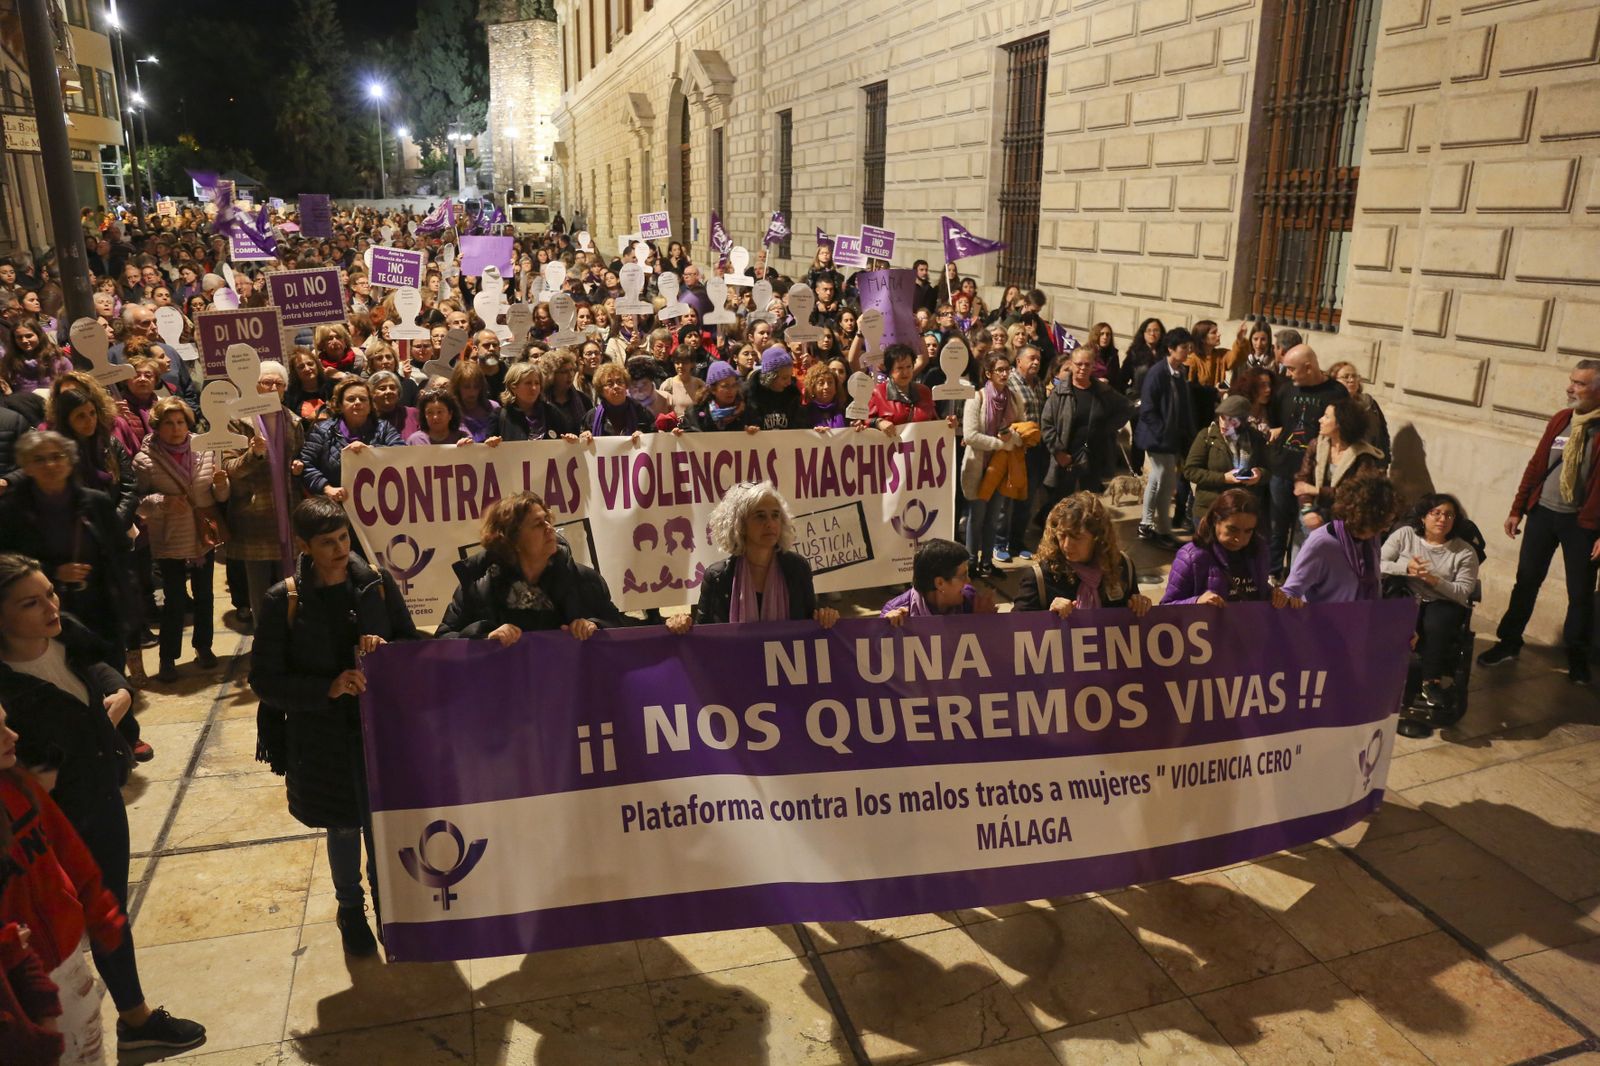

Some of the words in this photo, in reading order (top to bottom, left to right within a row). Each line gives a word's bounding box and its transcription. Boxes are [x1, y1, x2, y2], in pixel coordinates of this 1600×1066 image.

[377, 272, 386, 282] TE
[387, 262, 404, 274] ¡NO
[387, 273, 414, 286] CALLES!
[284, 282, 298, 298] DI
[303, 275, 327, 296] NO
[299, 300, 333, 309] Violencia
[314, 309, 343, 317] mujeres
[214, 324, 229, 342] DI
[235, 316, 263, 340] NO
[206, 360, 226, 368] cont
[353, 462, 502, 527] CONTRA
[597, 448, 778, 510] VIOLENCIAS
[795, 436, 946, 499] MACHISTAS
[806, 521, 816, 538] A
[823, 516, 841, 532] LA
[807, 547, 866, 570] TRIARCAL
[763, 638, 833, 686] NI
[855, 633, 992, 685] UNA
[1013, 621, 1213, 676] MENOS
[643, 703, 781, 755] NOS
[805, 683, 1148, 754] QUEREMOS
[1164, 671, 1287, 724] VIVAS
[621, 794, 764, 833] Plataforma
[769, 793, 848, 821] contra
[855, 787, 891, 817] los
[899, 782, 970, 813] malos
[975, 779, 1043, 808] tratos
[1049, 781, 1063, 801] a
[1069, 770, 1152, 805] mujeres
[1171, 755, 1252, 789] VIOLENCIA
[1257, 747, 1292, 775] CERO
[976, 815, 1072, 850] MÁLAGA
